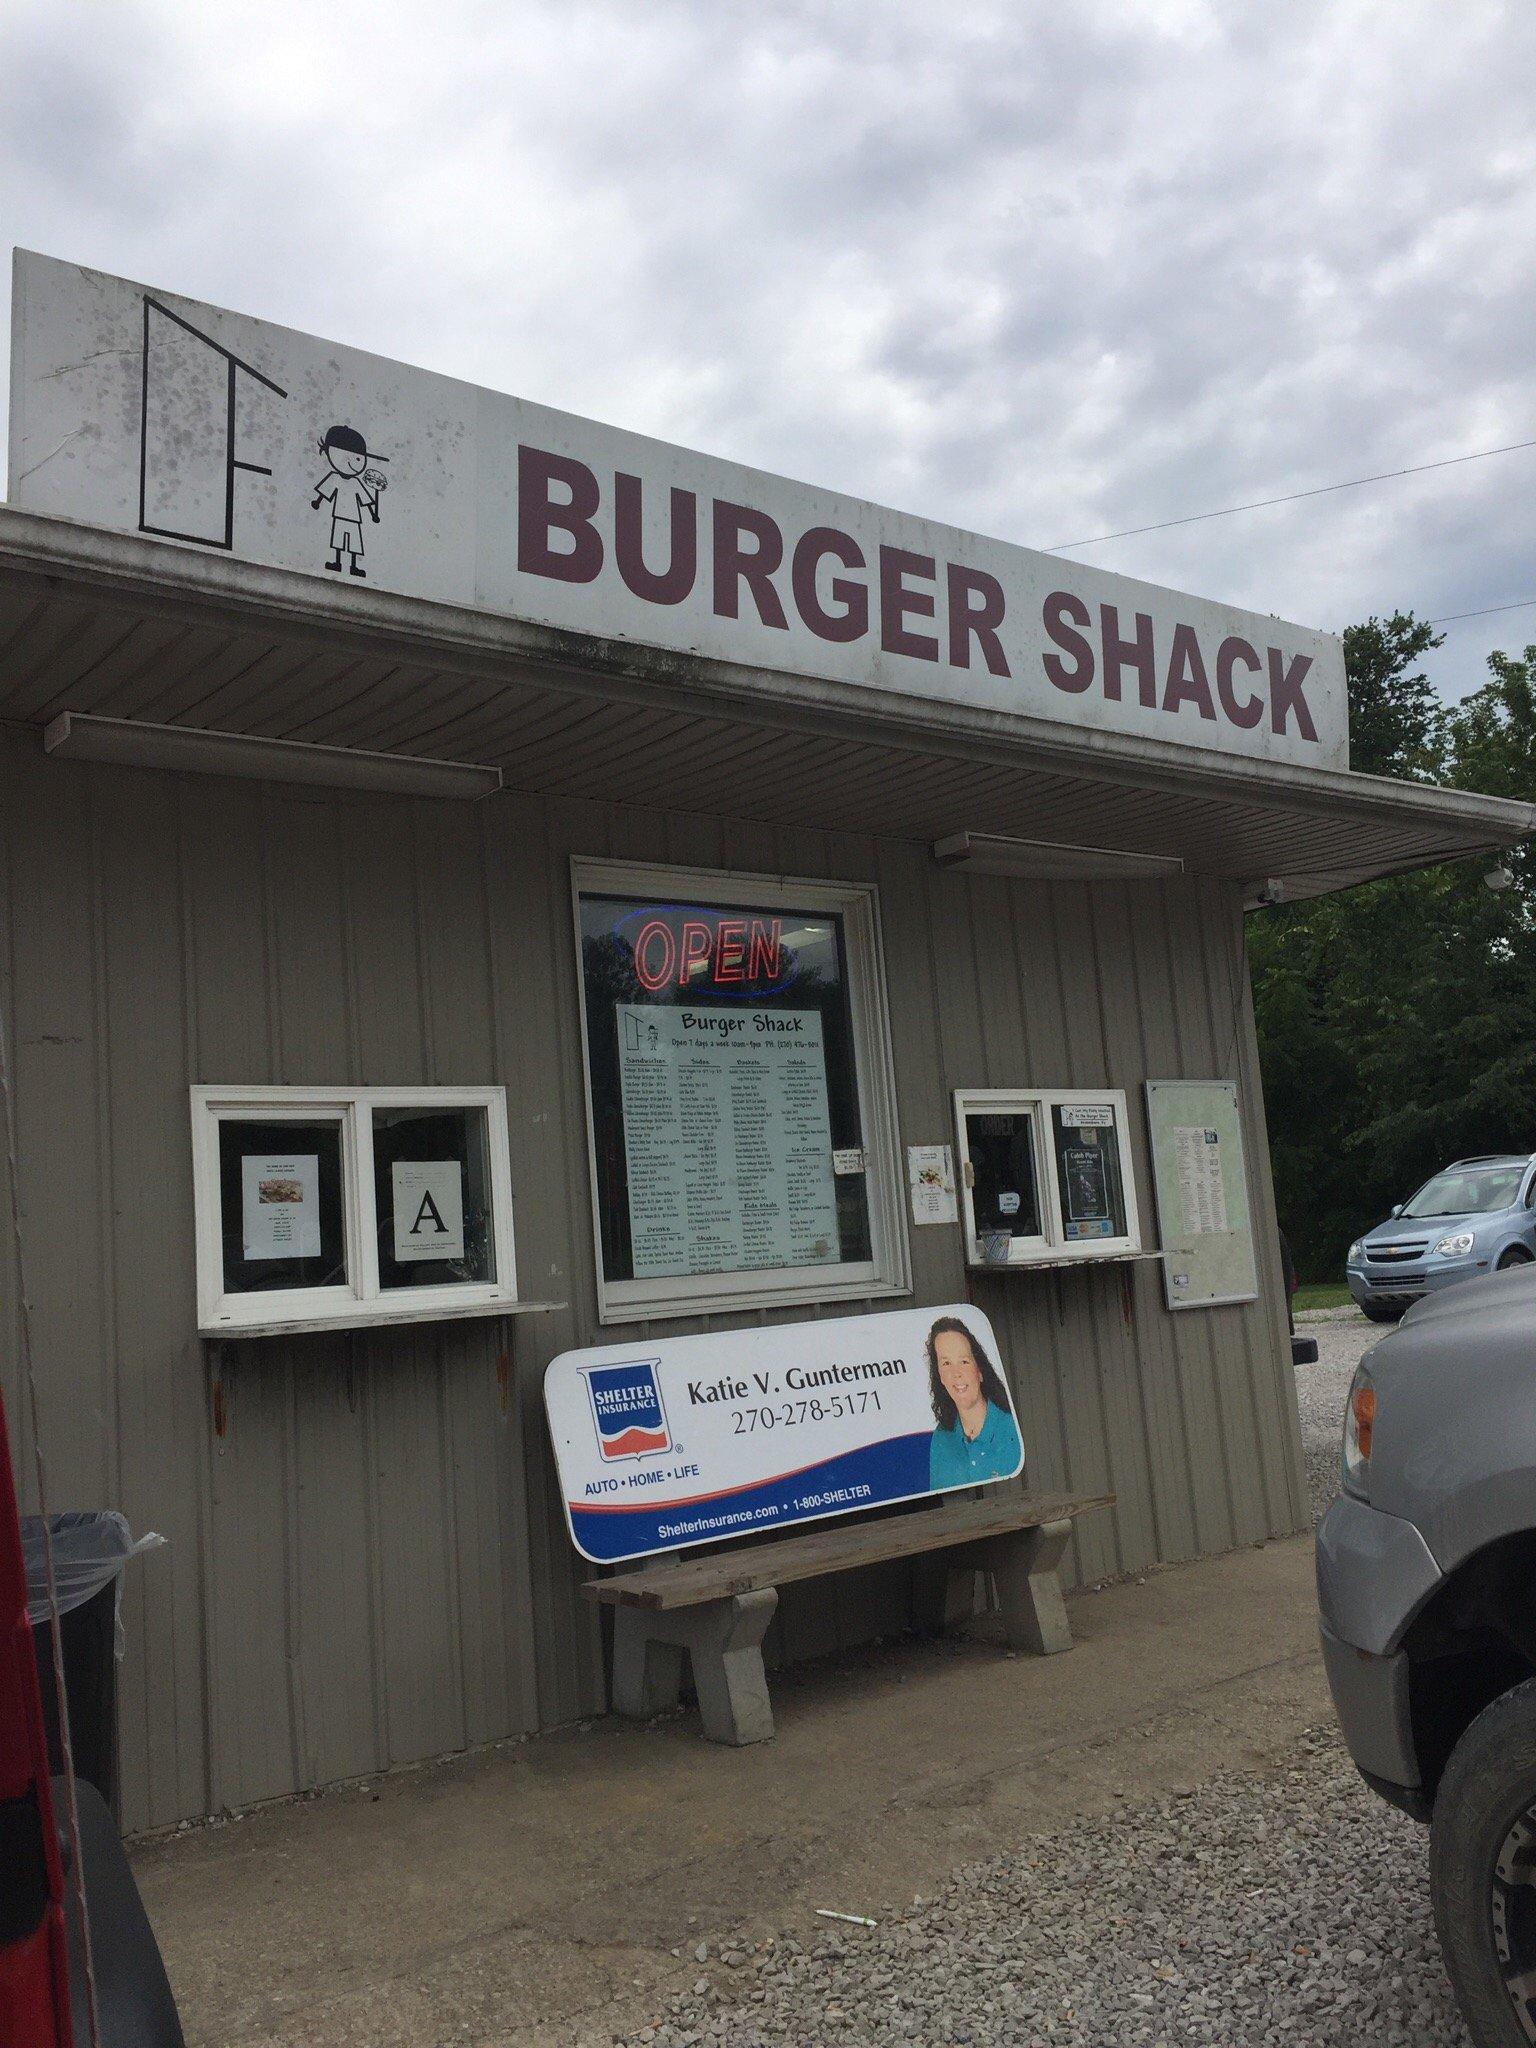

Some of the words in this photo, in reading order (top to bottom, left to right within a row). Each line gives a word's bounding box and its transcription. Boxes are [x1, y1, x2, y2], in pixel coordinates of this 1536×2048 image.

[517, 444, 1011, 677] BURGER
[1042, 591, 1319, 743] SHACK
[634, 919, 781, 991] OPEN
[681, 1013, 745, 1037] Burger
[752, 1014, 804, 1032] Shack
[671, 1038, 687, 1048] Open
[694, 1039, 708, 1049] days
[625, 1056, 666, 1065] Sandwiches
[690, 1057, 711, 1065] Sides
[409, 1189, 449, 1234] A
[759, 1201, 777, 1209] Meals
[687, 1375, 750, 1406] Katie
[753, 1371, 781, 1395] V.
[785, 1355, 907, 1391] Gunterman
[594, 1384, 655, 1406] SHELTER
[598, 1398, 657, 1416] INSURANCE
[731, 1389, 883, 1435] 270-278-5171
[585, 1478, 618, 1496] AUTO
[629, 1470, 665, 1488] HOME
[674, 1464, 700, 1480] LIFE
[657, 1504, 779, 1540] ShelterInsurance.com
[792, 1483, 871, 1511] 1-800-SHELTER
